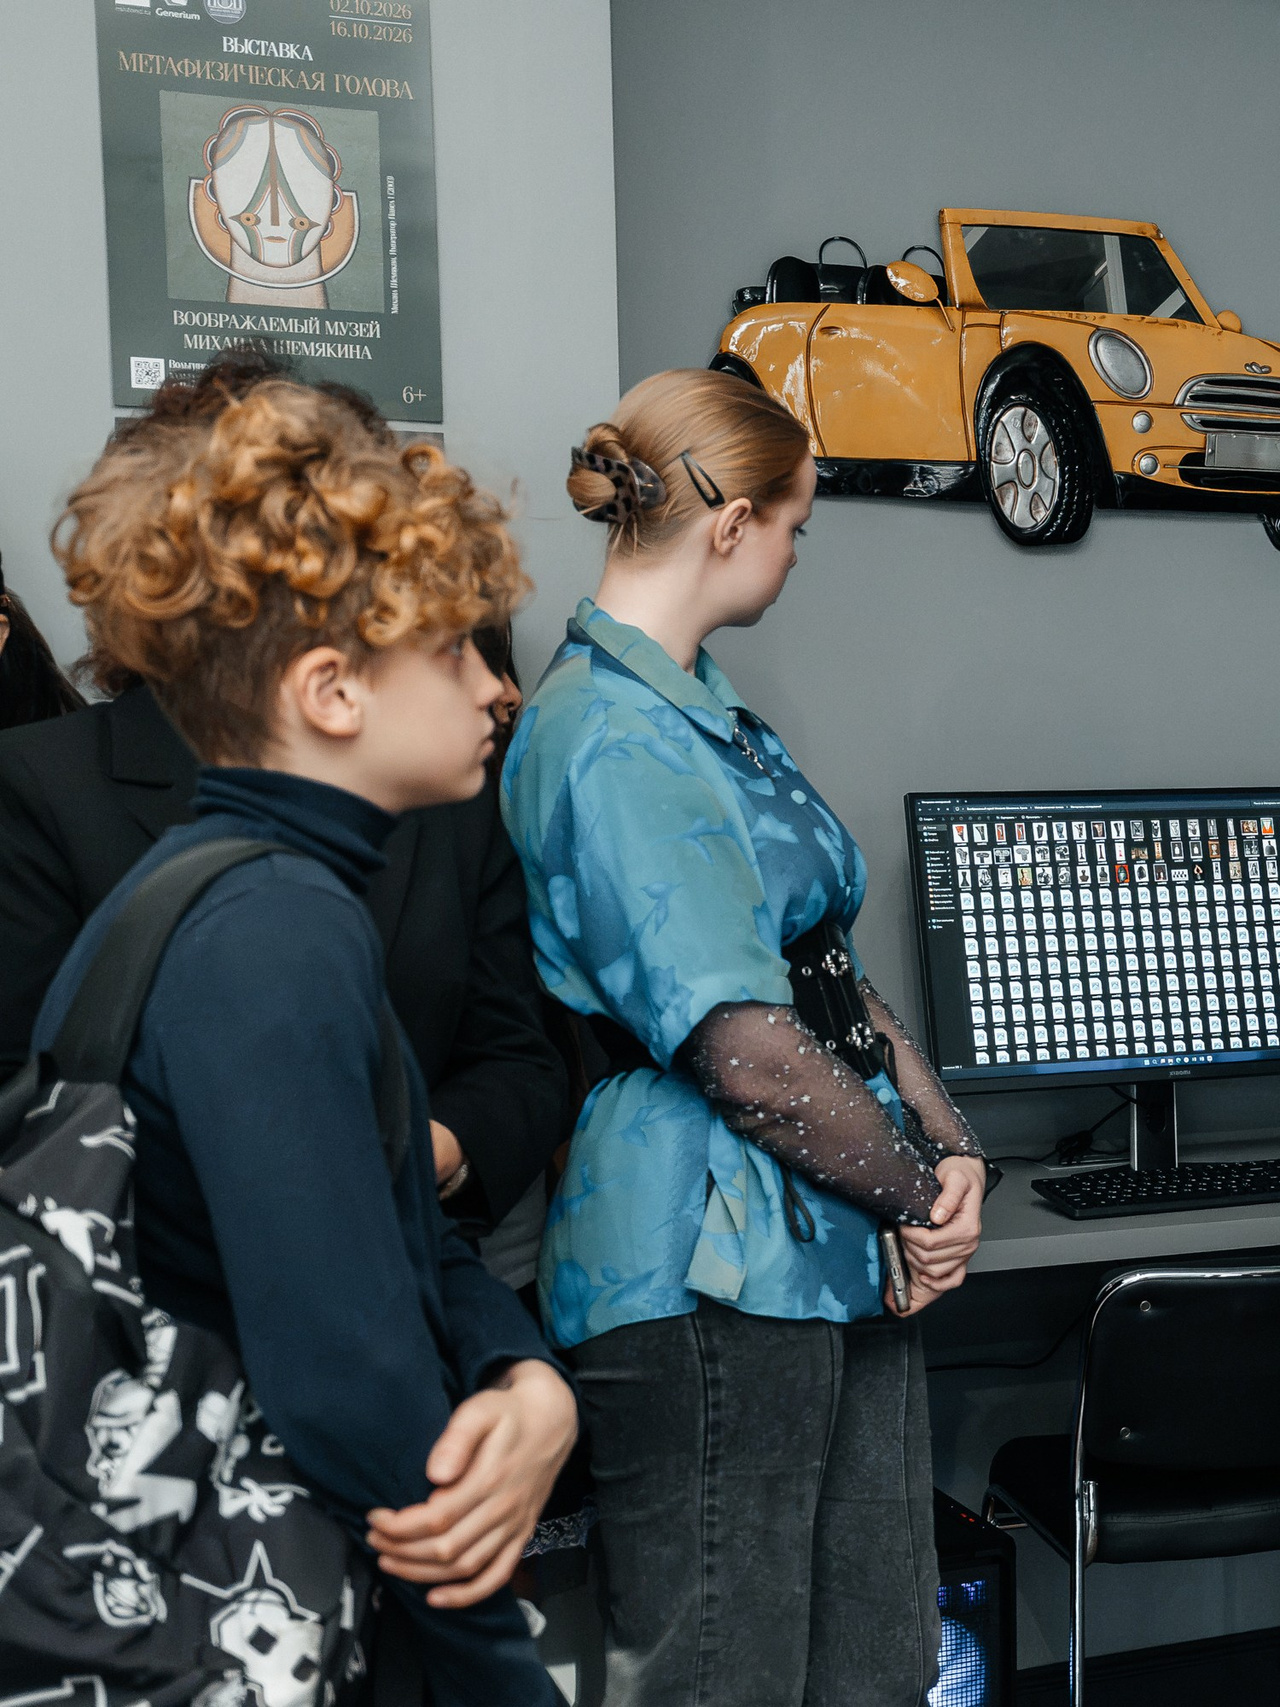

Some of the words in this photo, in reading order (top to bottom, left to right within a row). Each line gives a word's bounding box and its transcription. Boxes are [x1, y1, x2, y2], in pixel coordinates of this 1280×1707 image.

[155, 7, 201, 21] Generium
[330, 0, 412, 20] 02.10.2026
[330, 20, 413, 43] 16.10.2026
[222, 36, 313, 61] ВЫСТАВКА
[117, 51, 326, 92] МЕТАФИЗИЧЕСКАЯ
[334, 74, 414, 100] ГОЛОВА
[173, 310, 321, 335] ВООБРАЖАЕМЫЙ
[325, 320, 381, 339] МУЗЕЙ
[402, 386, 427, 404] 6+
